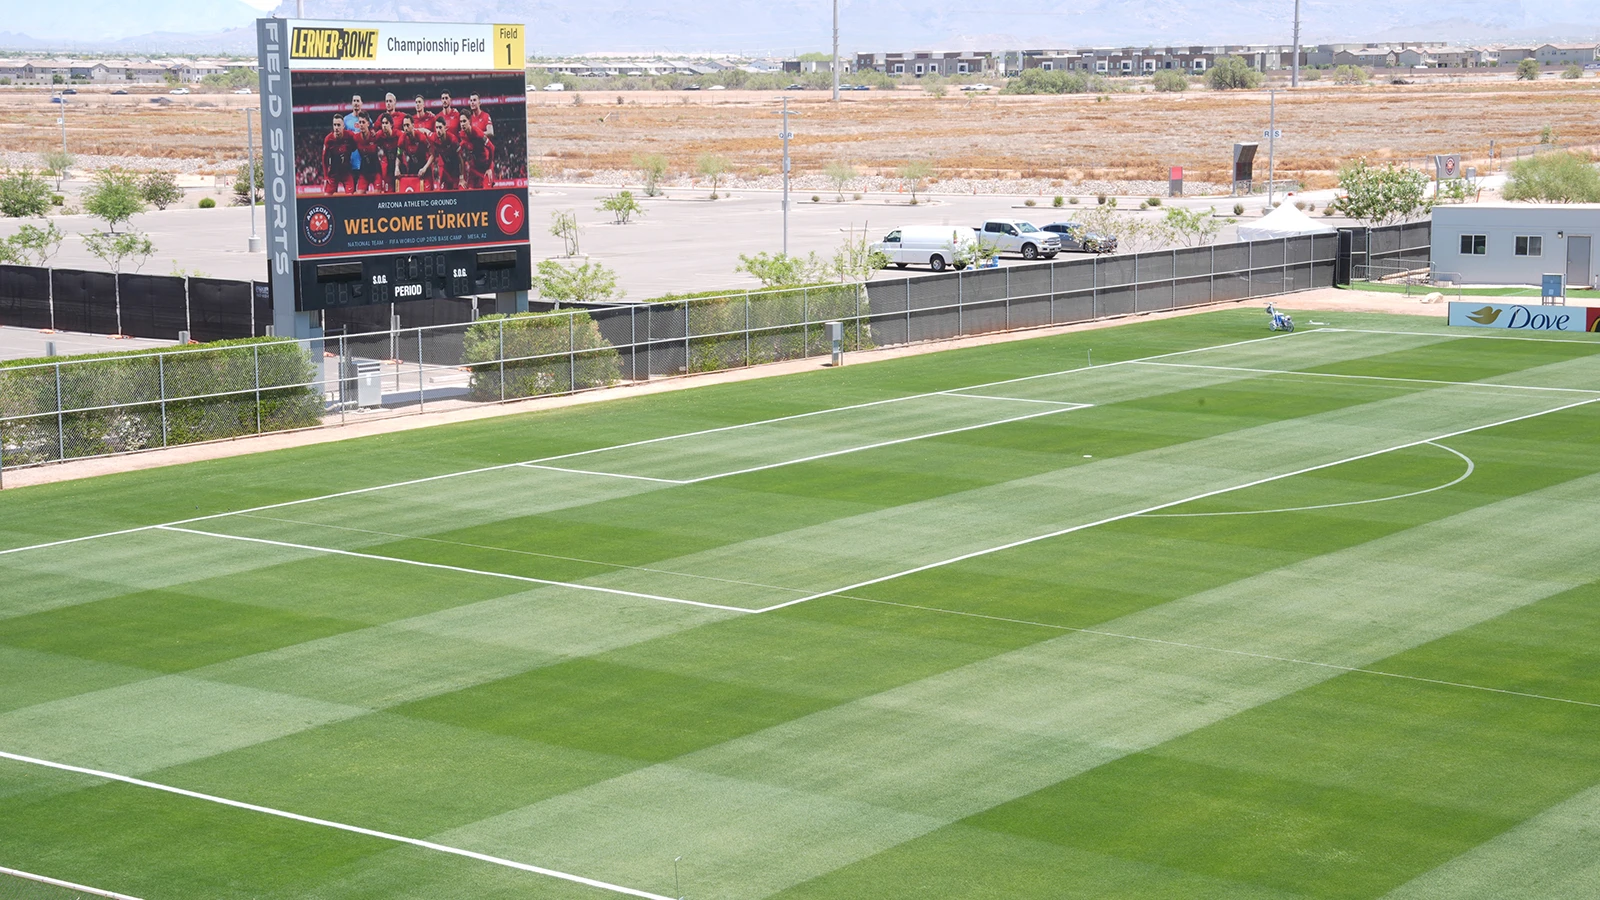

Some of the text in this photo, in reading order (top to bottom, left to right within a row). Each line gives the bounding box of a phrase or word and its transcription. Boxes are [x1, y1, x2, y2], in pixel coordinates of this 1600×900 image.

[500, 28, 517, 39] Field
[387, 37, 485, 55] Championship Field
[506, 43, 511, 65] 1
[265, 22, 282, 118] FIELD
[270, 127, 289, 275] SPORTS
[377, 199, 457, 209] ARIZONA ATHLETIC GROUNDS
[306, 207, 331, 221] ARIZONA
[344, 215, 423, 235] WELCOME
[427, 210, 488, 230] TÜRKIYE
[372, 275, 388, 285] S.O.G.
[453, 268, 467, 278] S.O.G.
[394, 284, 422, 297] PERIOD
[1507, 304, 1570, 331] Dove
